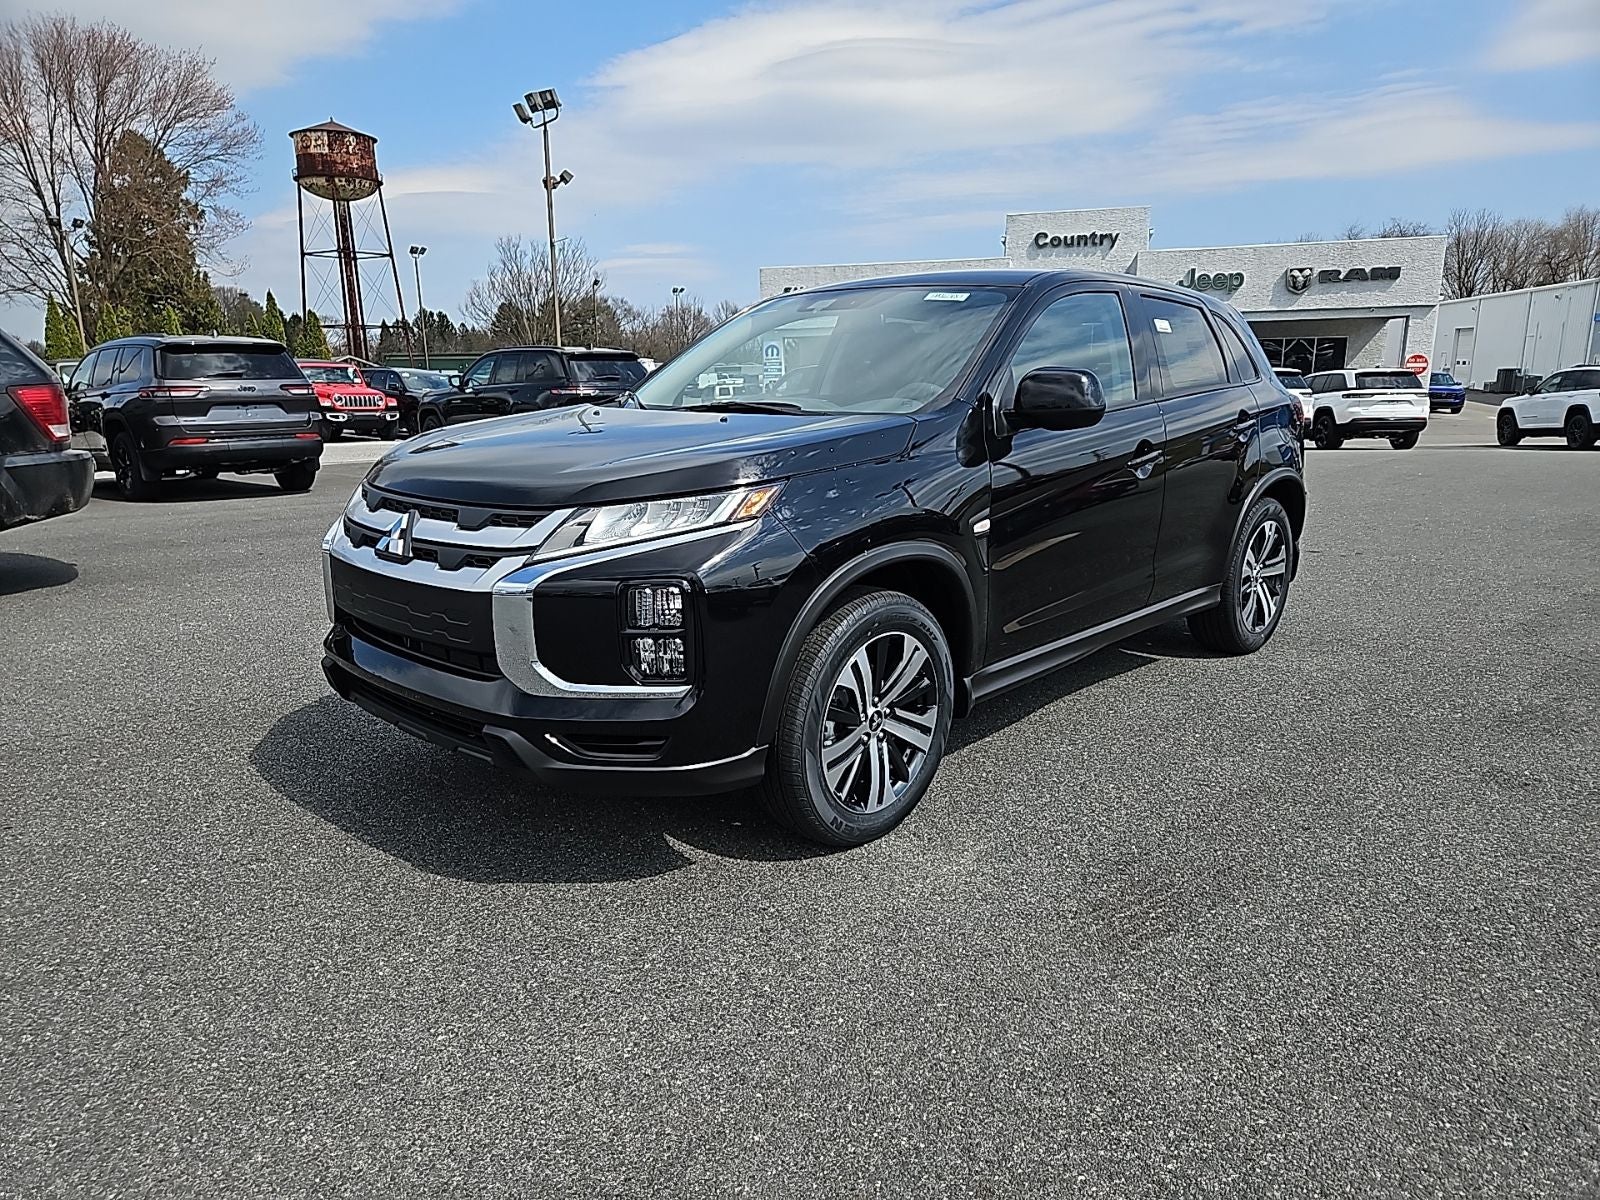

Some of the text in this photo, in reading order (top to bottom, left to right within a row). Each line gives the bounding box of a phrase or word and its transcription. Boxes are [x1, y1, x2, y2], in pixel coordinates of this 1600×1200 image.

[1034, 231, 1120, 250] Country
[1176, 267, 1245, 292] Jeep
[1318, 266, 1402, 284] RAM
[237, 384, 257, 393] Jeep
